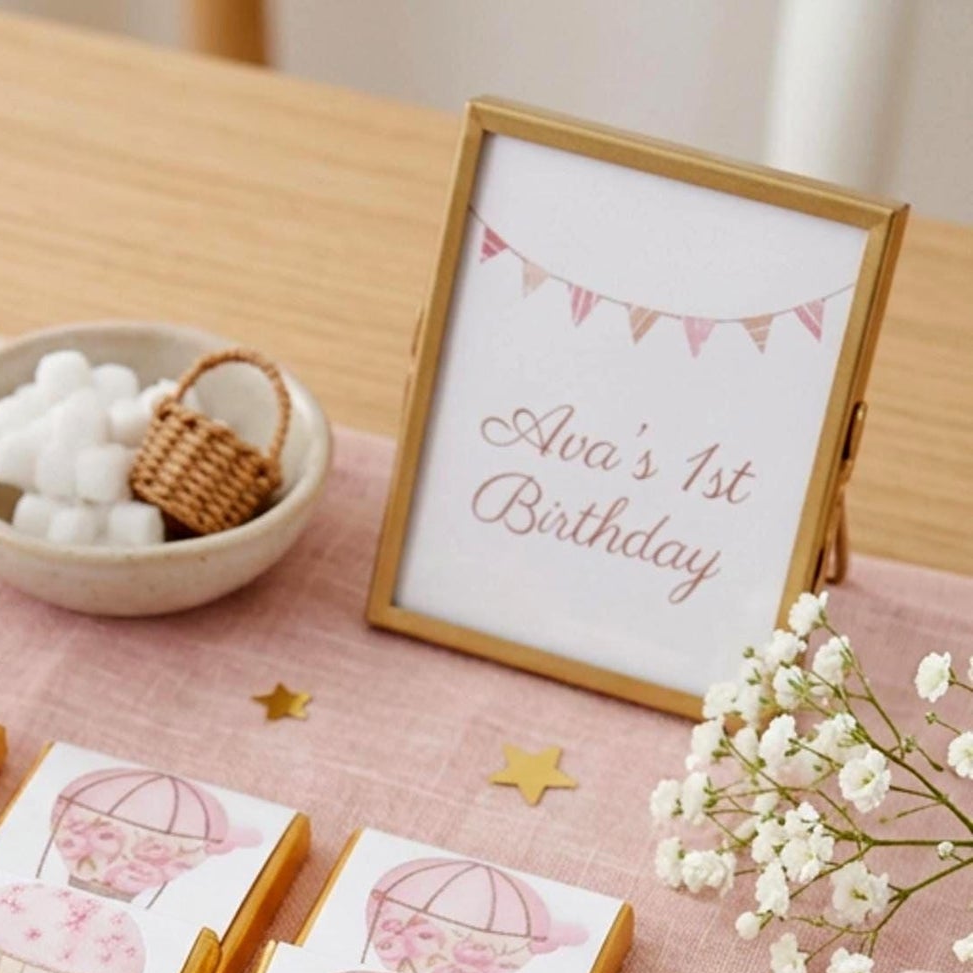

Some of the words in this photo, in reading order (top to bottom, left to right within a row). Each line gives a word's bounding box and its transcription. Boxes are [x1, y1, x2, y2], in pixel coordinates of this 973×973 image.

[480, 404, 658, 480] Ava's
[682, 443, 756, 504] 1st
[471, 472, 722, 604] Birthday
